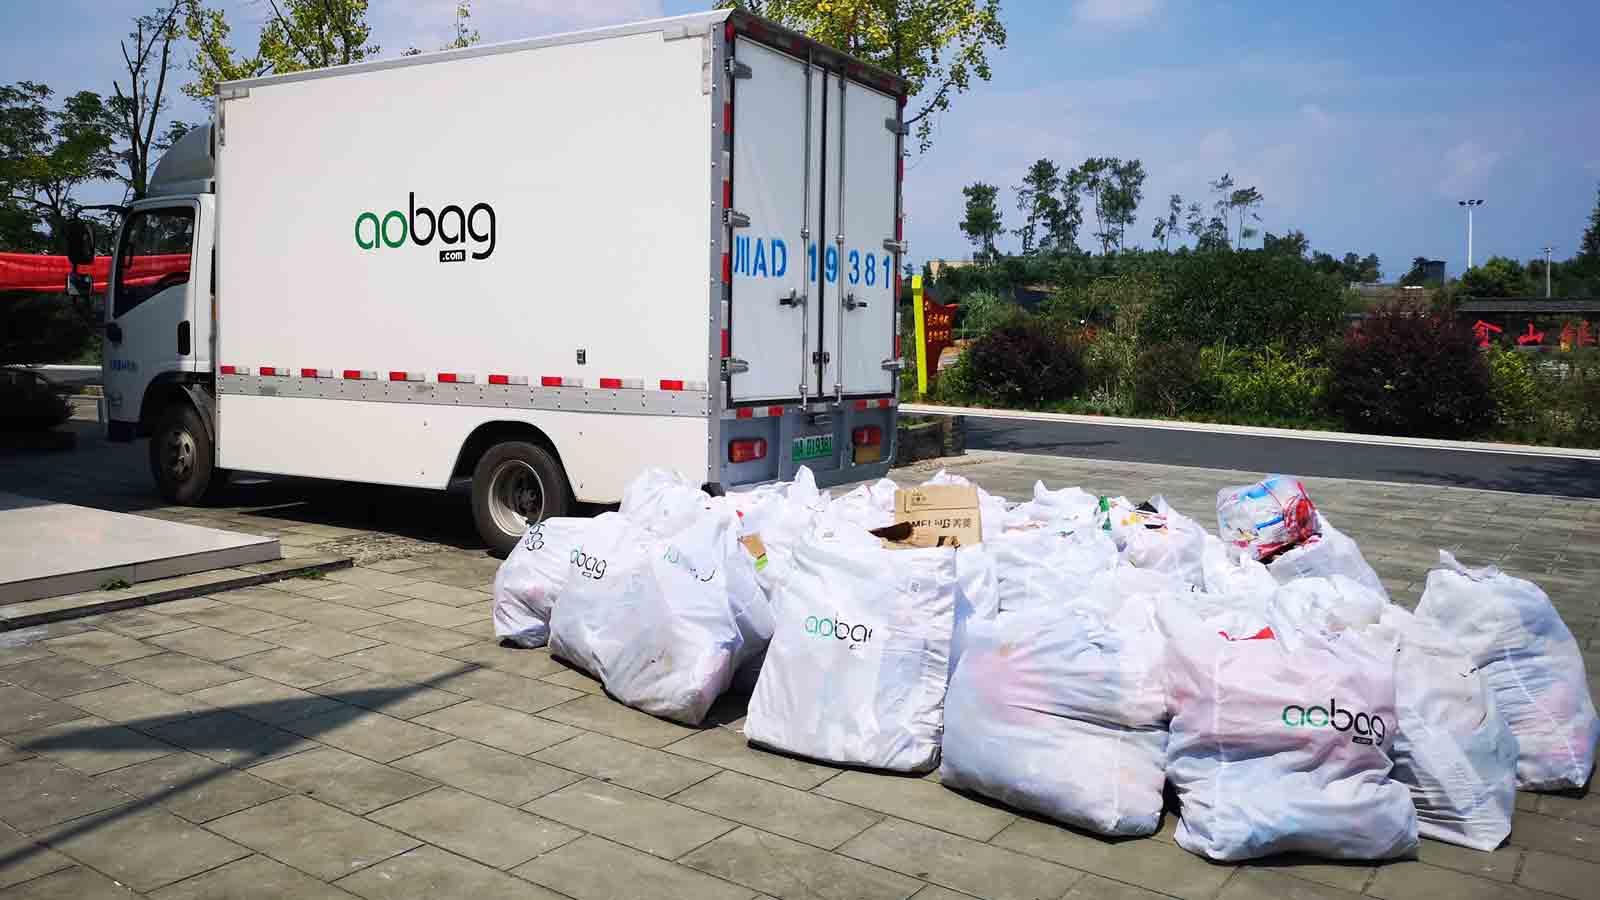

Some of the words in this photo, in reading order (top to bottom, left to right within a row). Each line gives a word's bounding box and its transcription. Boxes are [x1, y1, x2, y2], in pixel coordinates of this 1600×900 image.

[355, 192, 496, 260] aobag
[808, 243, 891, 289] 19381
[1282, 698, 1385, 746] aobag
